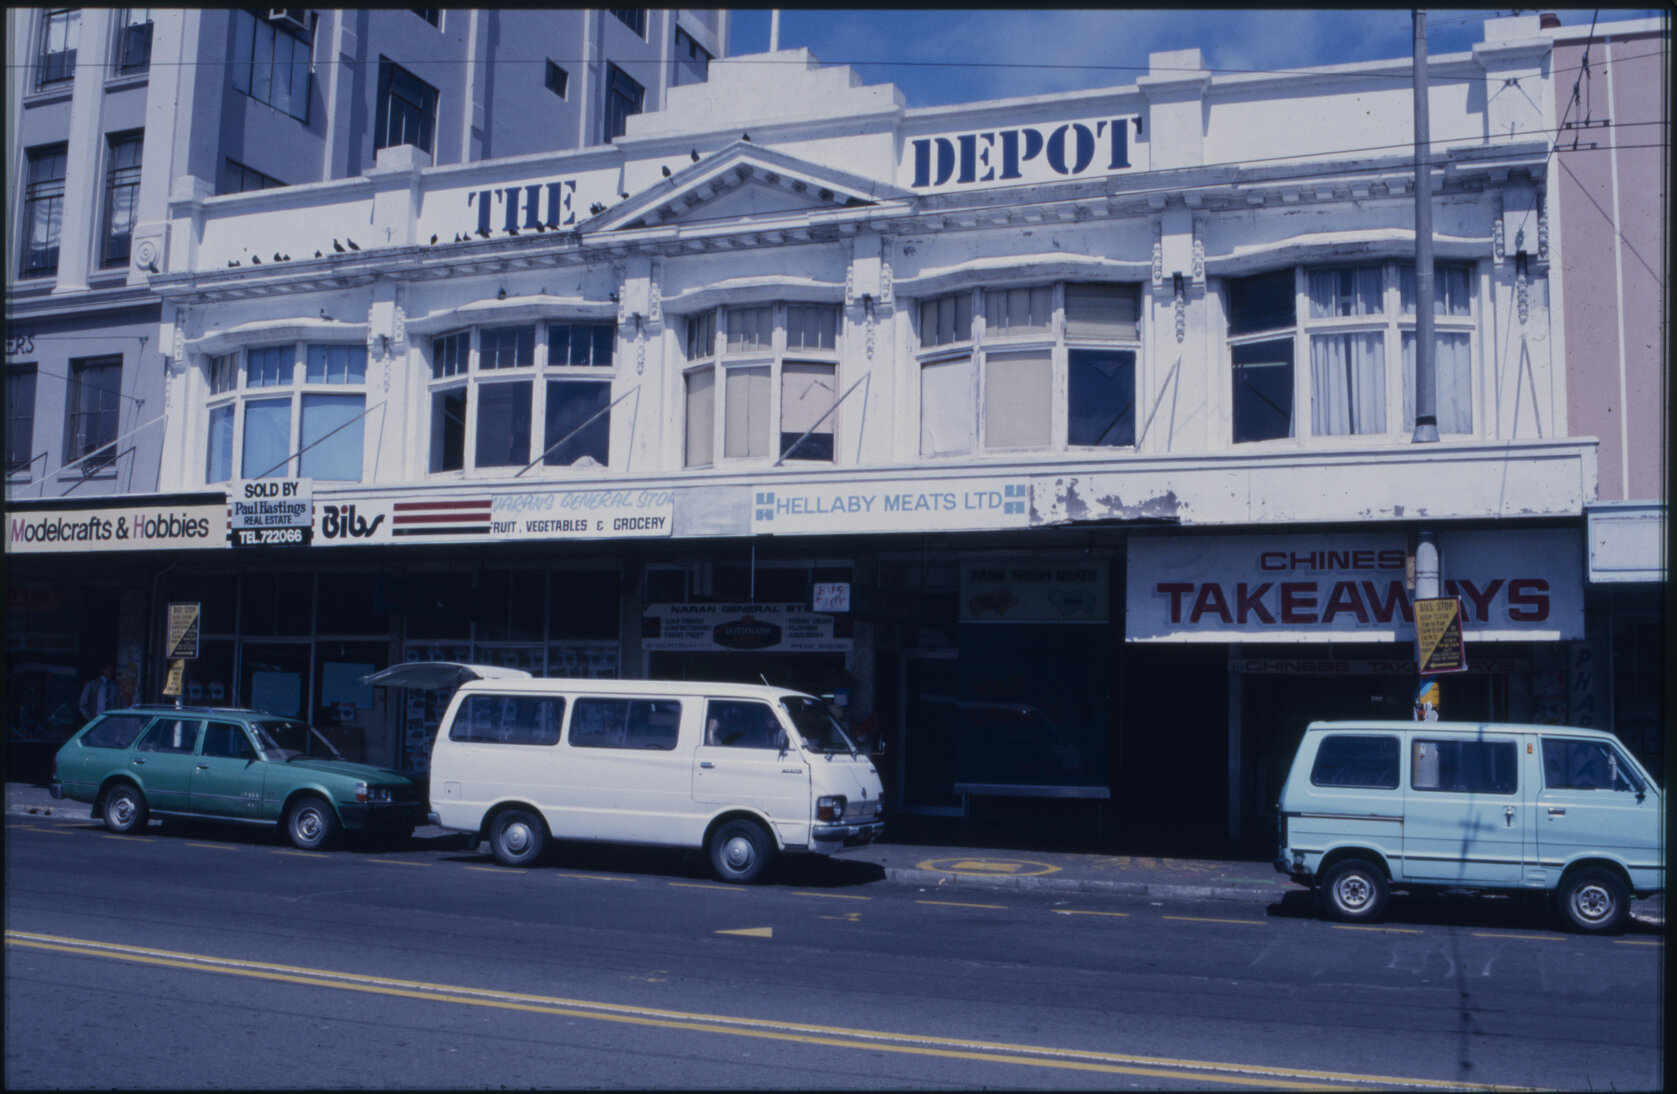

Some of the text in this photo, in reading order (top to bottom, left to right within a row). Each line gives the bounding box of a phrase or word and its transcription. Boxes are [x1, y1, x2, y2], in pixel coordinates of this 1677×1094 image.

[468, 117, 1142, 234] THE DEPOT
[244, 481, 299, 498] SOLD BY
[235, 501, 306, 517] Paul Hastings
[492, 494, 554, 513] NARANS
[560, 490, 632, 511] GENERAL
[776, 490, 1003, 515] HELLABY MEATS LTD
[11, 512, 209, 543] Modelcrafts & Hobbies
[244, 515, 292, 525] REAL ESTATE
[322, 504, 385, 539] Bibs
[525, 518, 588, 533] VEGETABLES
[613, 516, 666, 531] GROCERY
[1259, 550, 1406, 571] CHINES
[1055, 568, 1097, 582] MEATS
[671, 604, 804, 614] NARAN GENERAL ST
[1419, 601, 1454, 612] BUS STOP
[1245, 660, 1351, 672] CHINESE
